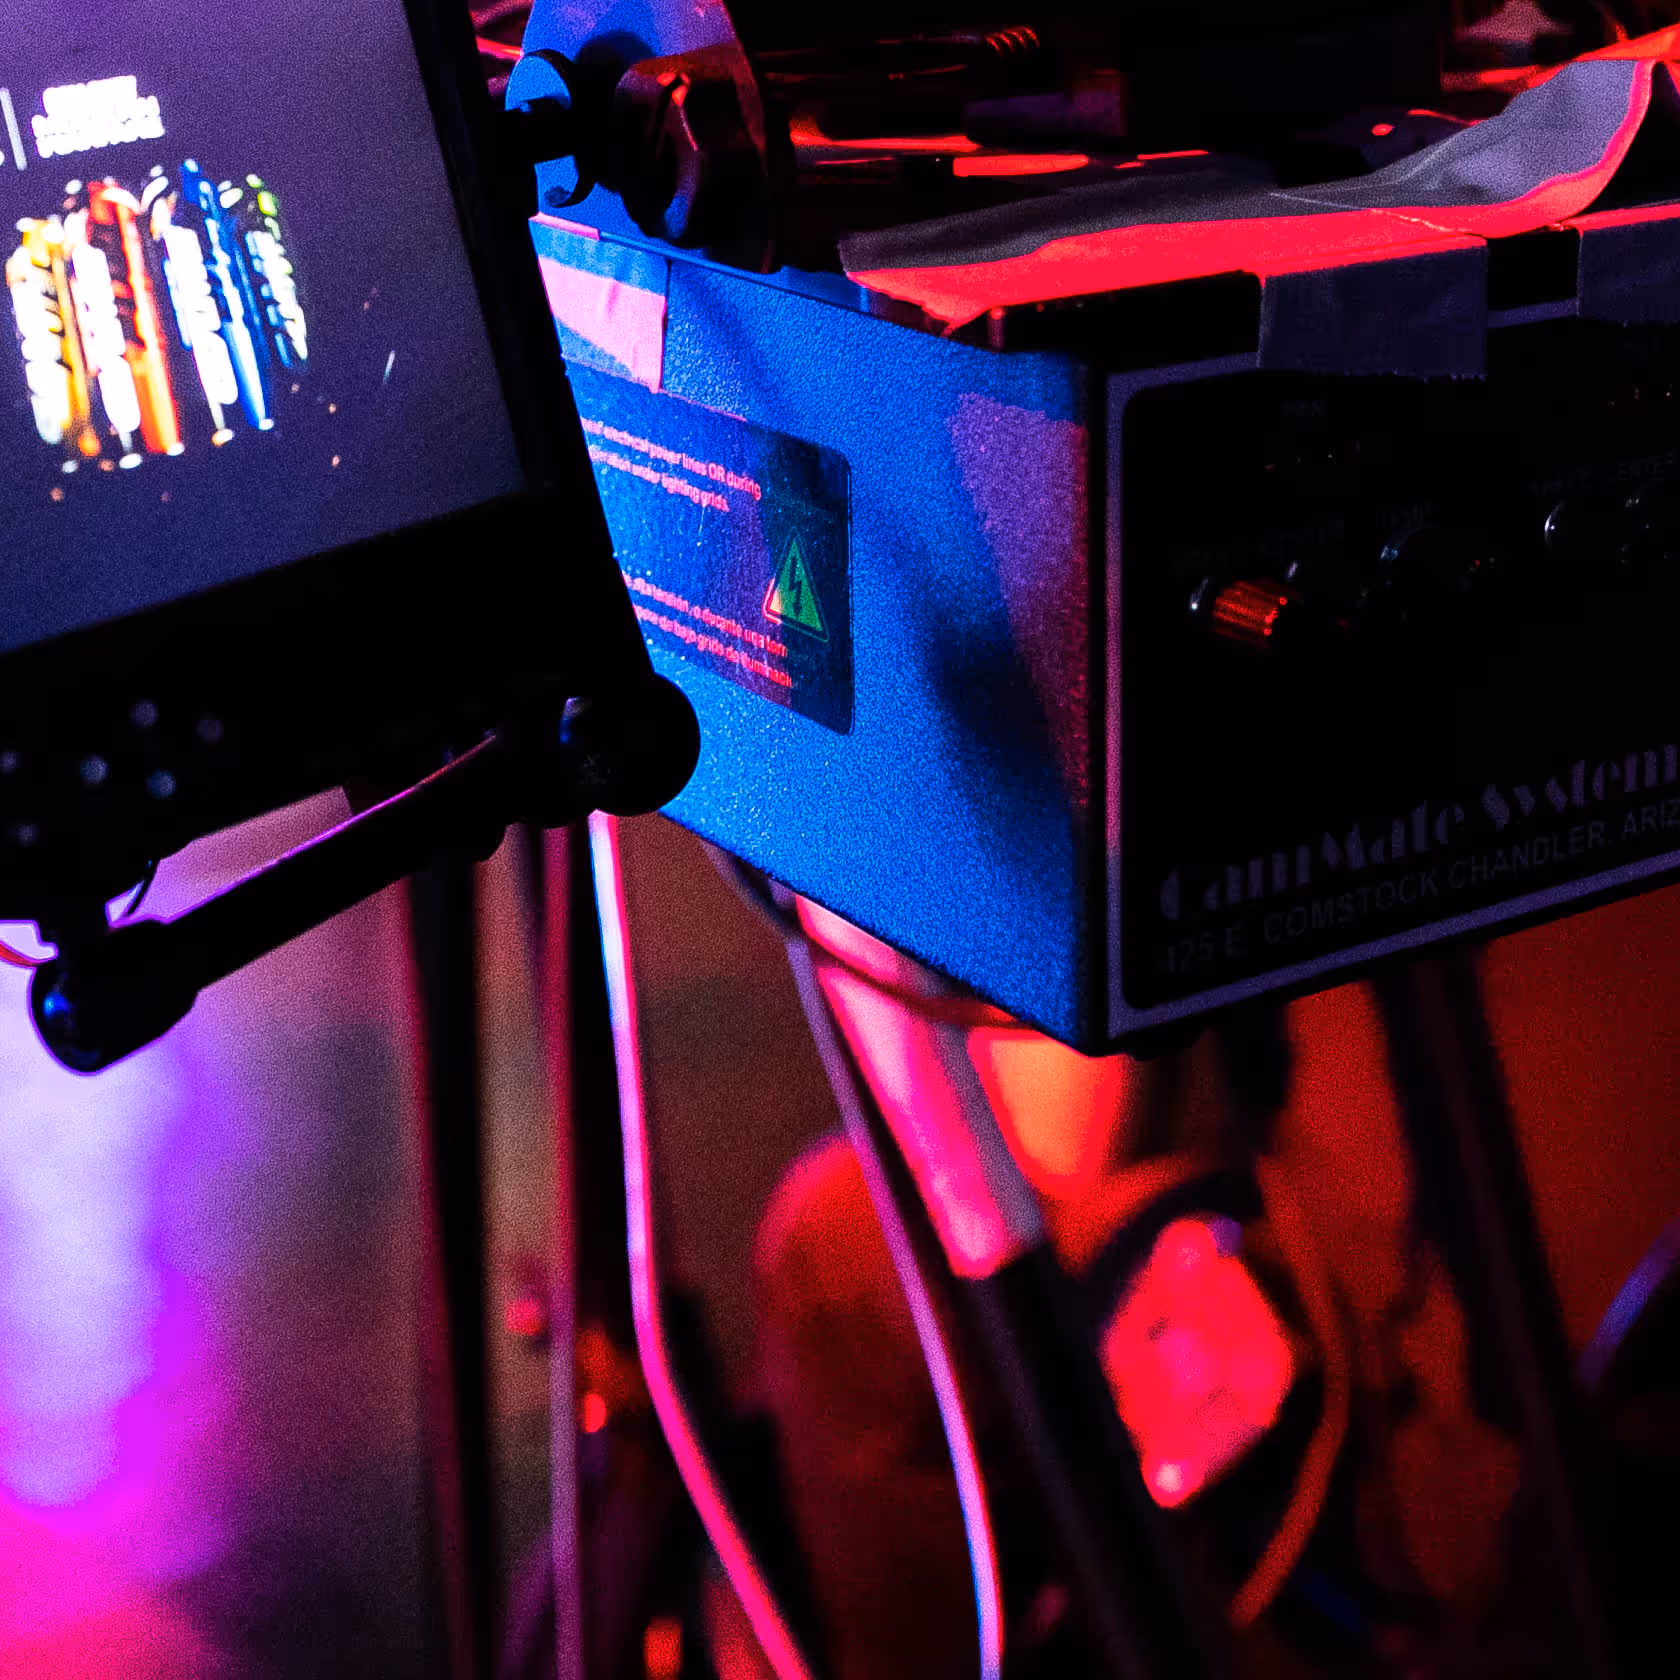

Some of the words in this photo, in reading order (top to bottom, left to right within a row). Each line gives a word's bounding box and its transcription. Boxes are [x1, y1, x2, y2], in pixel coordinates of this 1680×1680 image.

[708, 462, 725, 483] OR
[725, 471, 761, 501] during
[1263, 872, 1440, 945] COMSTOCK
